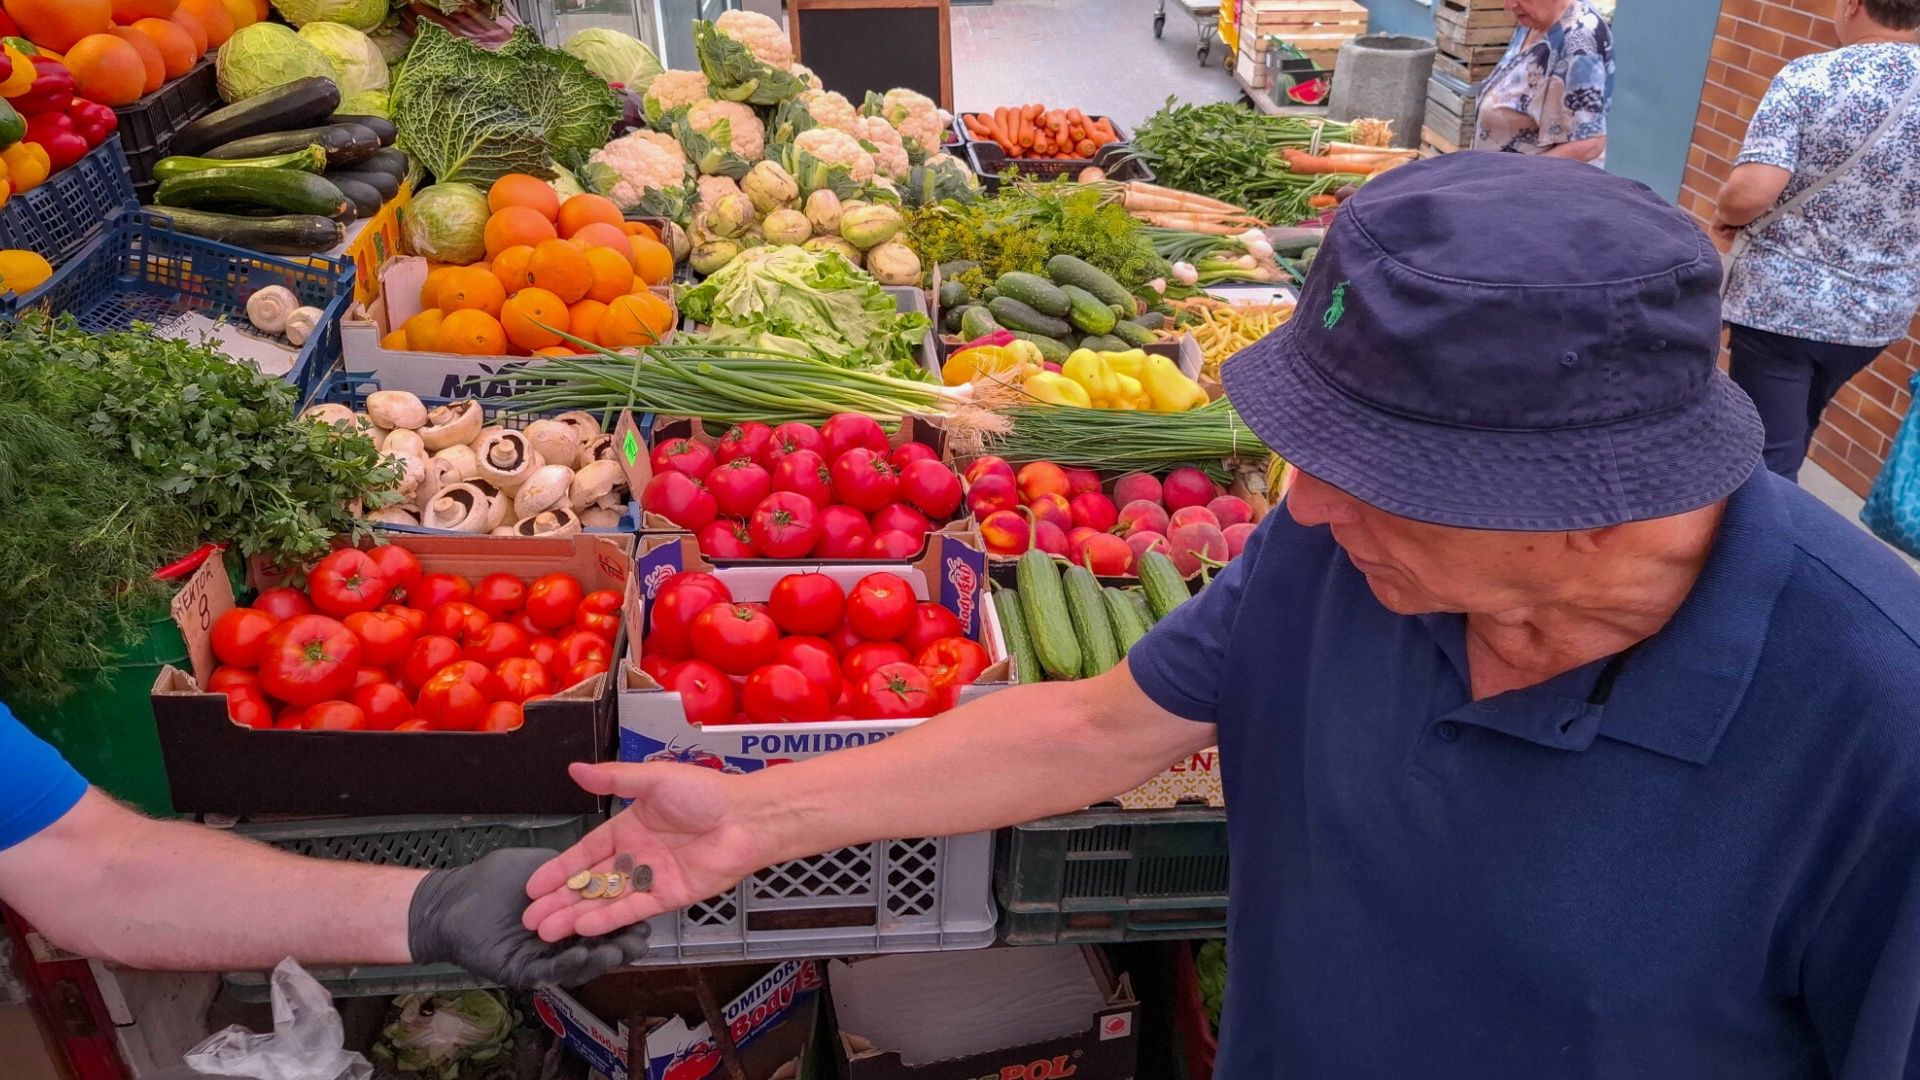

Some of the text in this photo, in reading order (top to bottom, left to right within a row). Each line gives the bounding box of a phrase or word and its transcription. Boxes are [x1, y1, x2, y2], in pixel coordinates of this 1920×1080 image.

[199, 594, 210, 631] 8
[741, 731, 895, 754] POMIDOR
[722, 960, 800, 1019] OMIDOR
[981, 1055, 1077, 1080] POL
